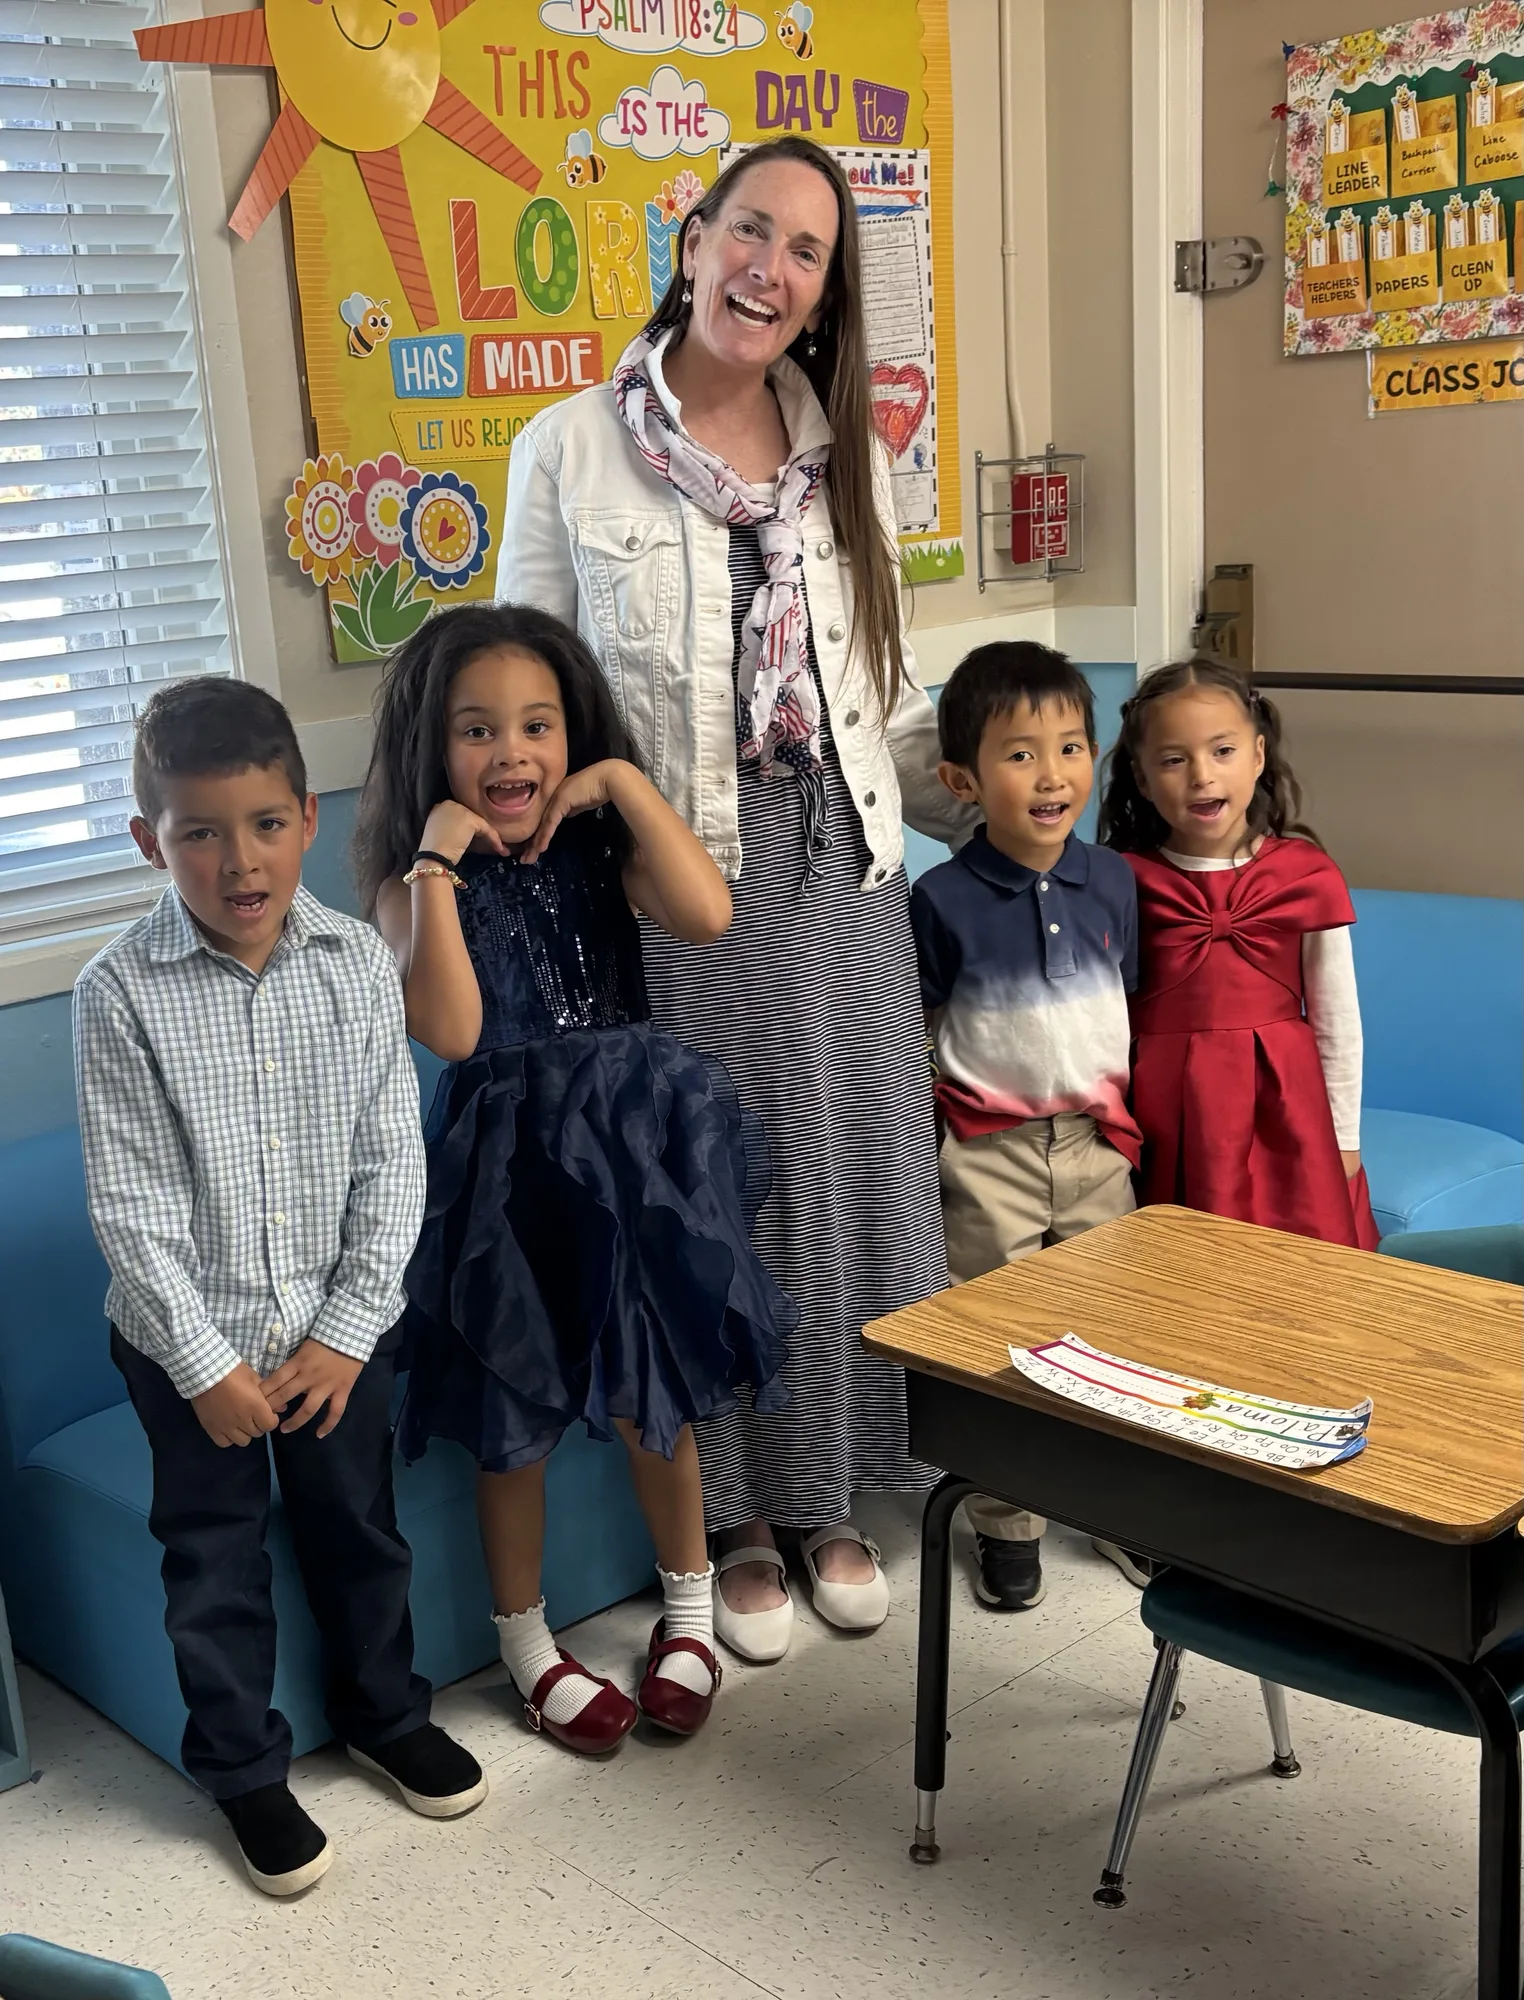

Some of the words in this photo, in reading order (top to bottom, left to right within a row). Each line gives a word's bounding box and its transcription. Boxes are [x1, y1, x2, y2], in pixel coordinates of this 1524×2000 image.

[580, 0, 665, 35] PSALM
[673, 0, 739, 47] 118:24
[483, 45, 592, 120] THIS
[755, 69, 840, 132] DAY
[862, 99, 898, 138] the
[620, 98, 648, 136] IS
[657, 101, 709, 138] THE
[1483, 134, 1506, 147] Line
[1474, 151, 1519, 168] Caboose
[848, 160, 878, 185] out
[881, 161, 915, 186] Me!
[1336, 161, 1369, 178] LINE
[1401, 166, 1436, 179] Carrier
[1328, 174, 1381, 196] LEADER
[1451, 260, 1494, 278] CLEAN
[1307, 276, 1360, 293] TEACHERS
[1375, 275, 1430, 294] PAPERS
[1464, 279, 1482, 292] UP
[1311, 289, 1357, 304] HELPERS
[402, 343, 459, 391] HAS
[483, 338, 595, 390] MADE
[1386, 363, 1480, 398] CLASS
[417, 419, 443, 451] LET
[451, 418, 476, 448] US
[482, 416, 532, 447] REJO
[1034, 486, 1065, 518] FRE
[1117, 1408, 1137, 1418] Hh
[1133, 1402, 1152, 1413] Uu
[1157, 1409, 1174, 1419] Tt
[1142, 1414, 1161, 1426] Gg
[1203, 1422, 1222, 1433] Rr
[1225, 1404, 1336, 1442] Paloma
[1162, 1423, 1183, 1433] Ff
[1189, 1430, 1208, 1441] Ee
[1214, 1439, 1235, 1450] Dd
[1255, 1437, 1271, 1448] Pp
[1280, 1443, 1300, 1453] Oo
[1241, 1445, 1259, 1456] Cc
[1266, 1452, 1286, 1463] Bb
[1306, 1448, 1327, 1459] Nn
